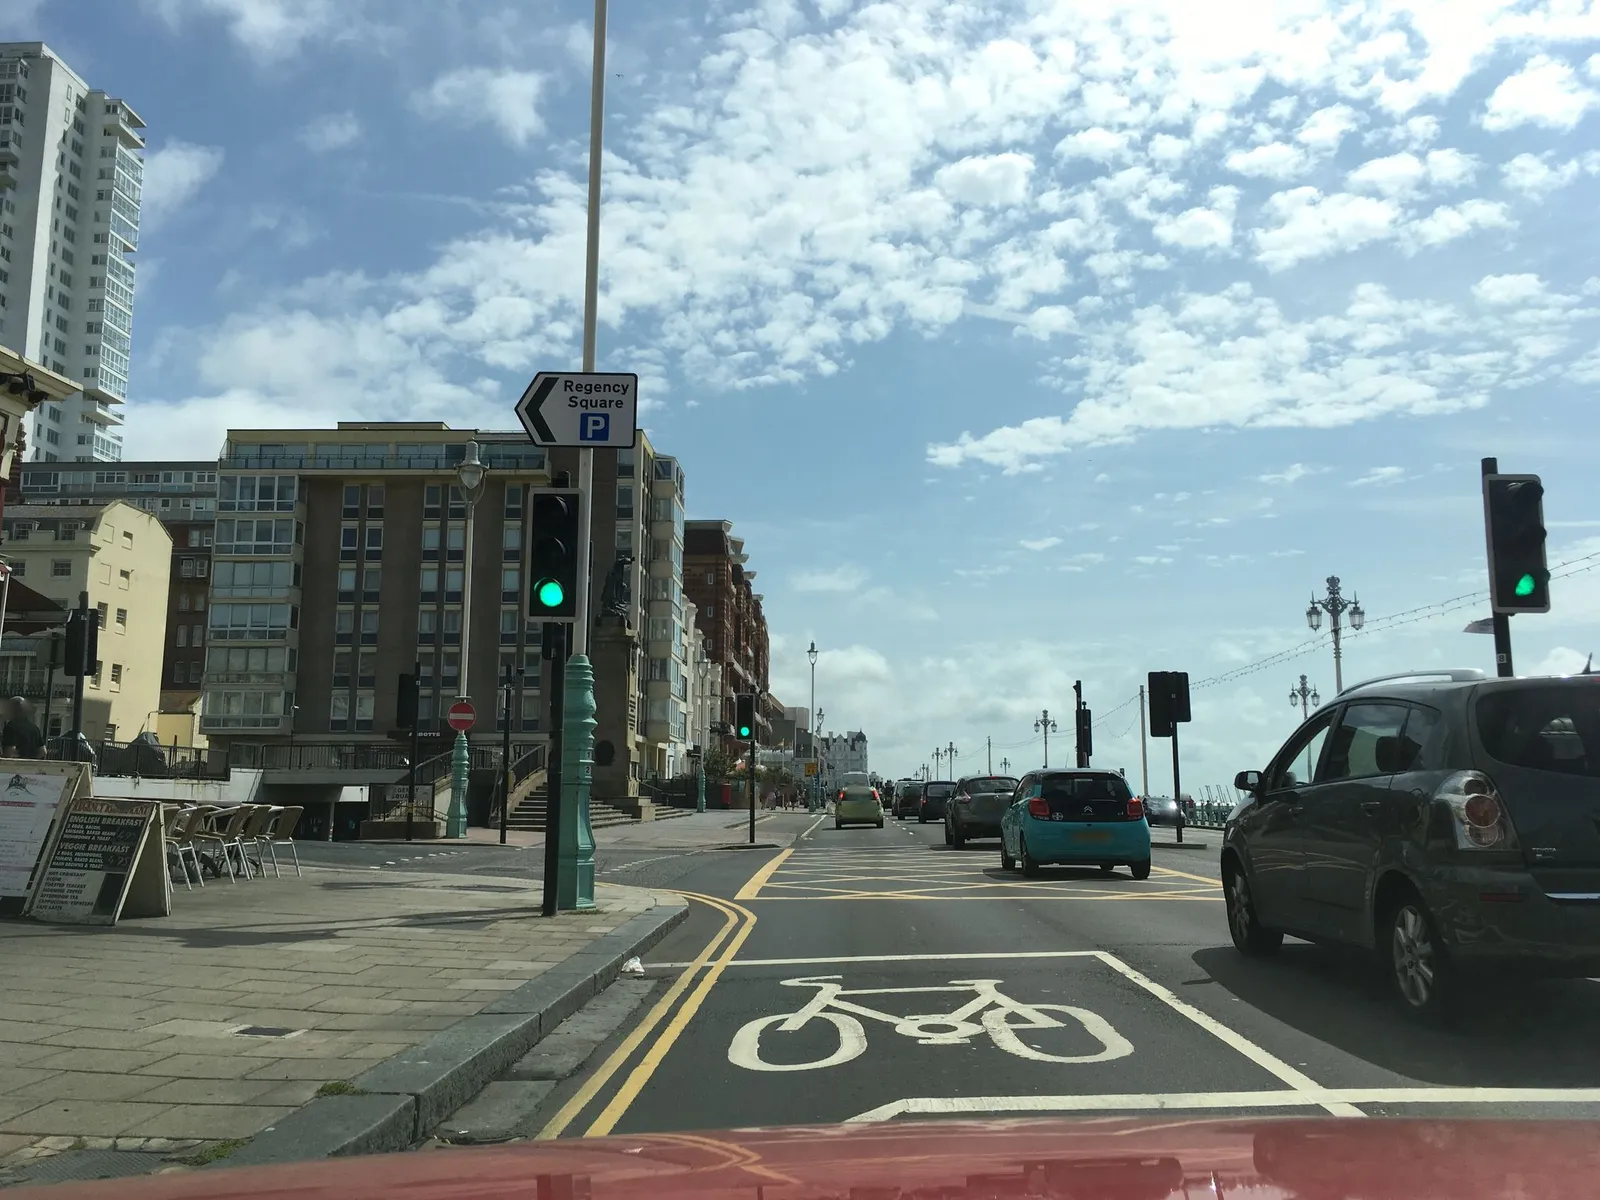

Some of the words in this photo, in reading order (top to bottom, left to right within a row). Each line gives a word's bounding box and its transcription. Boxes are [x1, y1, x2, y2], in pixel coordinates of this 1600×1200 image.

[564, 380, 630, 396] Regency
[568, 396, 625, 410] Square
[587, 416, 606, 439] P
[69, 816, 101, 824] ENGLISH
[102, 818, 145, 826] BREAKFAST
[88, 844, 130, 853] BREAKFAST
